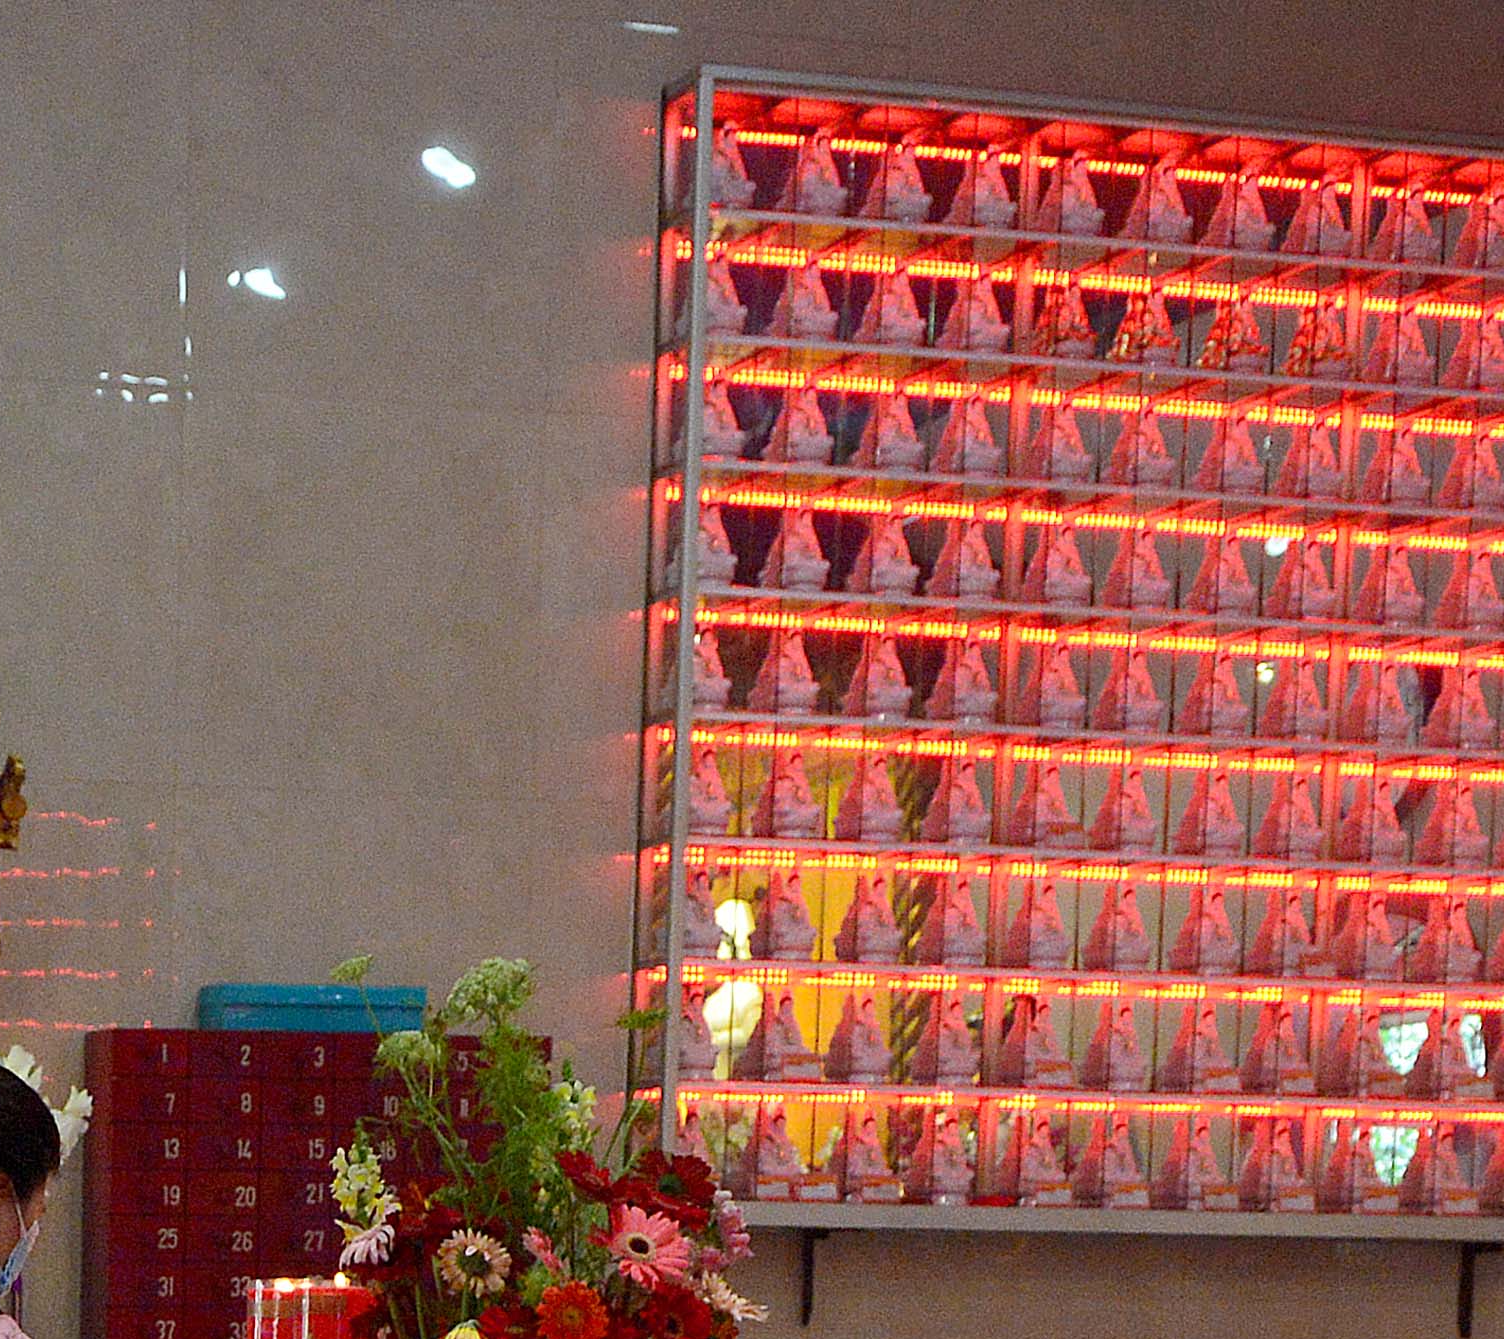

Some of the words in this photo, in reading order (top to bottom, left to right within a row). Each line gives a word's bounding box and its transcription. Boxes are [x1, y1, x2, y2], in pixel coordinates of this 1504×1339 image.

[161, 1043, 169, 1063] 1
[240, 1045, 252, 1066] 2
[313, 1047, 325, 1067] 3
[457, 1051, 469, 1072] 5
[165, 1092, 176, 1114] 7
[240, 1092, 252, 1113] 8
[313, 1095, 325, 1116] 9
[383, 1096, 400, 1117] 10
[163, 1137, 180, 1159] 13
[237, 1138, 253, 1160] 14
[308, 1138, 325, 1160] 15
[163, 1184, 181, 1206] 19
[235, 1186, 256, 1208] 20
[306, 1182, 324, 1204] 21
[157, 1228, 178, 1249] 25
[231, 1231, 253, 1252] 26
[303, 1230, 325, 1252] 27
[158, 1276, 175, 1298] 31
